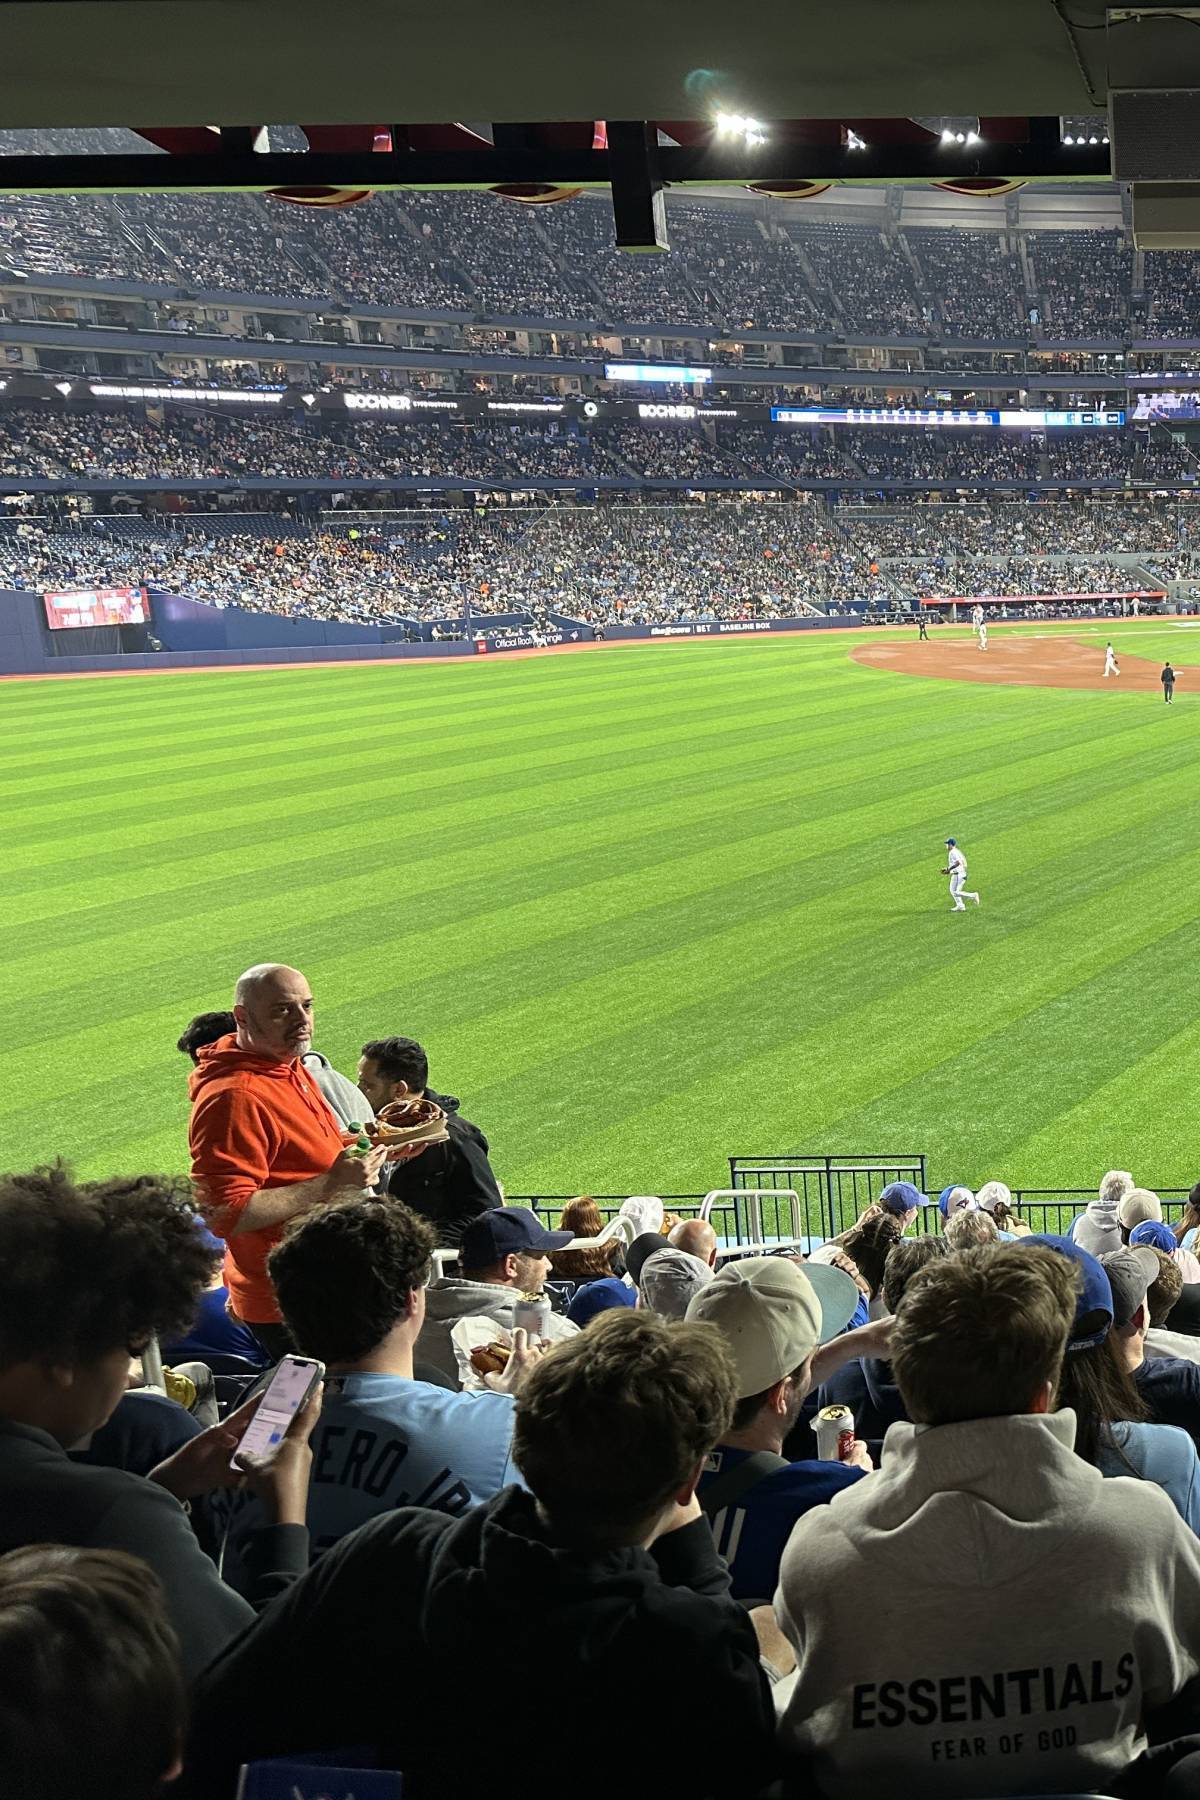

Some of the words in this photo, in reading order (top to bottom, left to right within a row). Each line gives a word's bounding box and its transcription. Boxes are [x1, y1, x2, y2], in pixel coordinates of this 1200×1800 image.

[638, 404, 696, 418] BOCHNER
[697, 625, 711, 633] BET
[314, 1425, 409, 1498] ERO
[852, 1652, 1135, 1730] ESSENTIALS
[931, 1736, 987, 1760] FEAR
[1001, 1733, 1024, 1754] OF
[1038, 1725, 1077, 1751] GOD
